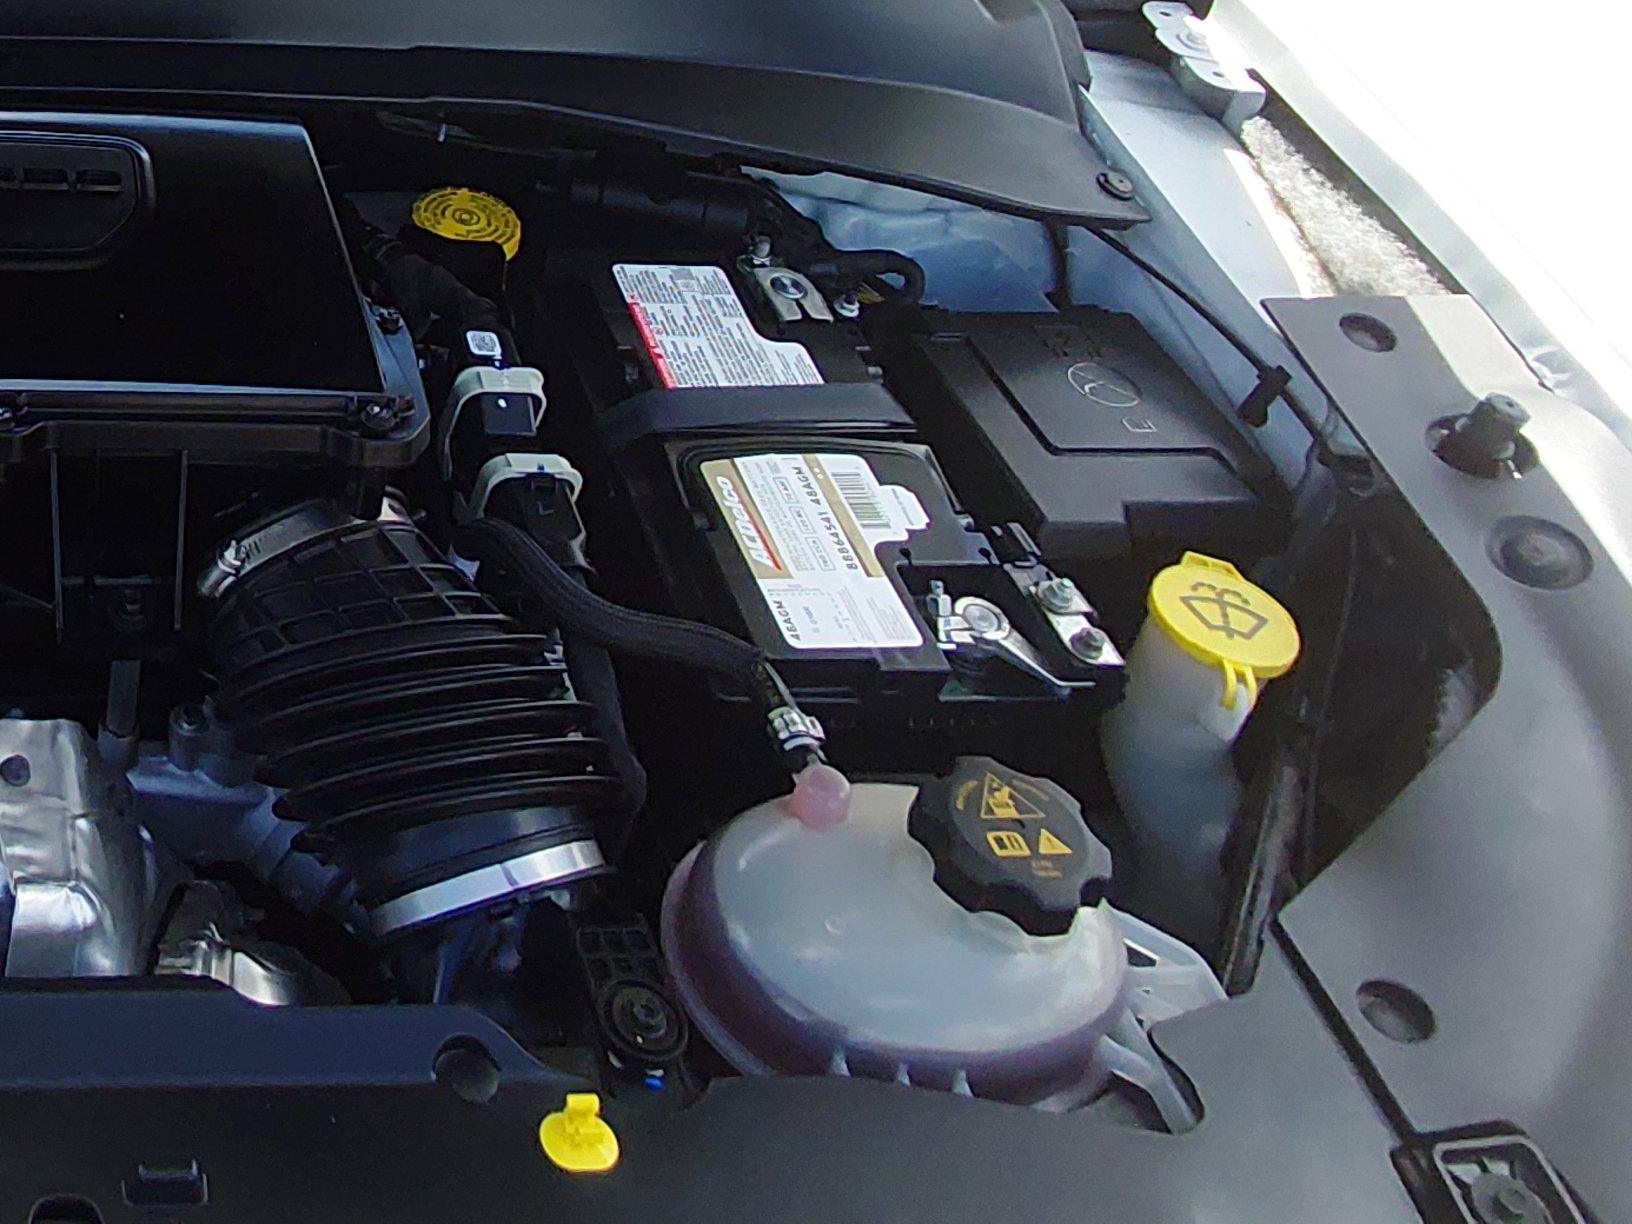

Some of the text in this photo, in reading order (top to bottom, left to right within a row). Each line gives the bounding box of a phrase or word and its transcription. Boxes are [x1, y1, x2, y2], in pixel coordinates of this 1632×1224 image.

[715, 475, 777, 569] ACDelco
[792, 466, 858, 571] 88864541 48AGM
[773, 600, 801, 642] 48AGM
